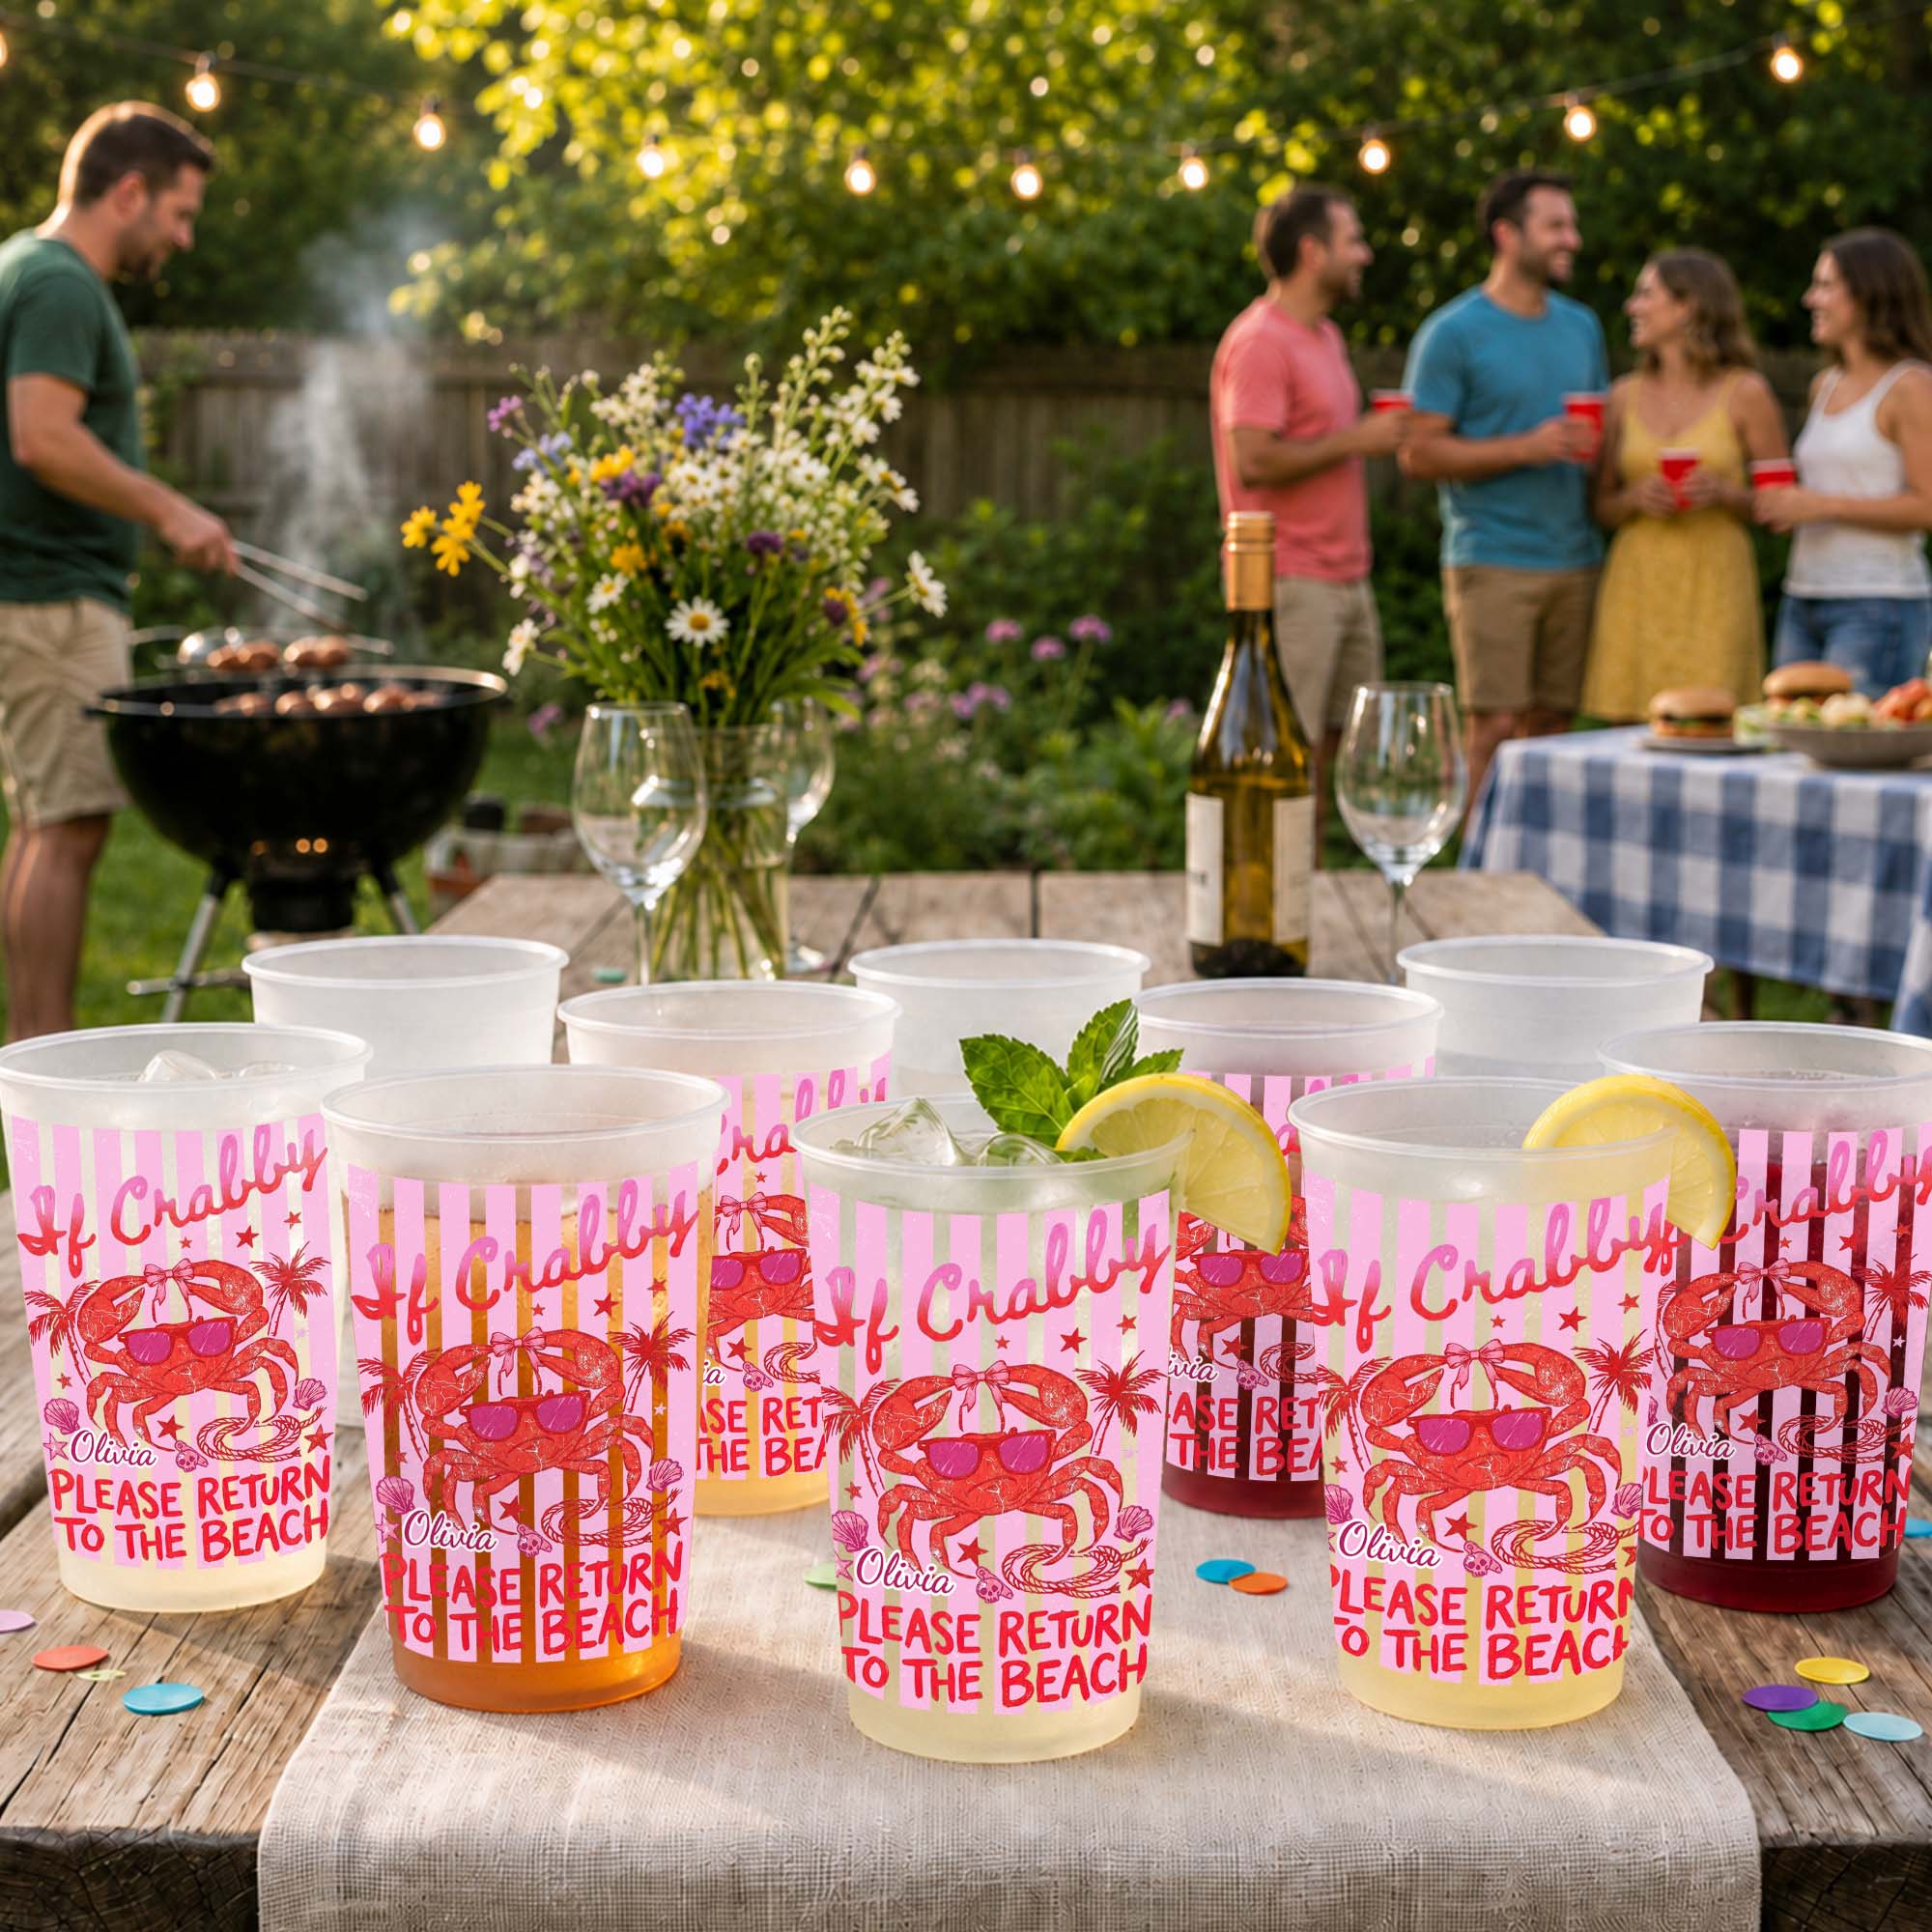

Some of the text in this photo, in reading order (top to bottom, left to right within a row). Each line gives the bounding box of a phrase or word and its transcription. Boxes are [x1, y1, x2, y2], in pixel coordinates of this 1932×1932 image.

[17, 1123, 328, 1279] If Crabby
[351, 1179, 700, 1346] If Crabby
[1312, 1197, 1664, 1353] If Crabby
[813, 1208, 1172, 1376] If Crabby
[1168, 1353, 1219, 1381] ivia
[763, 1396, 822, 1436] RET
[1255, 1396, 1321, 1435] RET
[71, 1432, 156, 1467] Olivia
[1169, 1433, 1241, 1471] THE
[1646, 1424, 1735, 1461] Olivia
[49, 1455, 330, 1520] PLEASE RETURN
[1642, 1464, 1912, 1513] LEASE RETURN
[54, 1498, 330, 1563] TO THE BEACH
[404, 1511, 497, 1550] Olivia
[1339, 1520, 1441, 1567] Olivia
[1687, 1514, 1758, 1549] THE
[1774, 1507, 1906, 1555] BEACH
[380, 1541, 684, 1609] PLEASE RETURN
[856, 1548, 955, 1594] Olivia
[384, 1587, 679, 1655] TO THE BEACH
[838, 1590, 1152, 1658] PLEASE RETURN
[1334, 1616, 1371, 1657] O
[1383, 1629, 1469, 1674] THE
[841, 1642, 1148, 1708] TO THE BEACH
